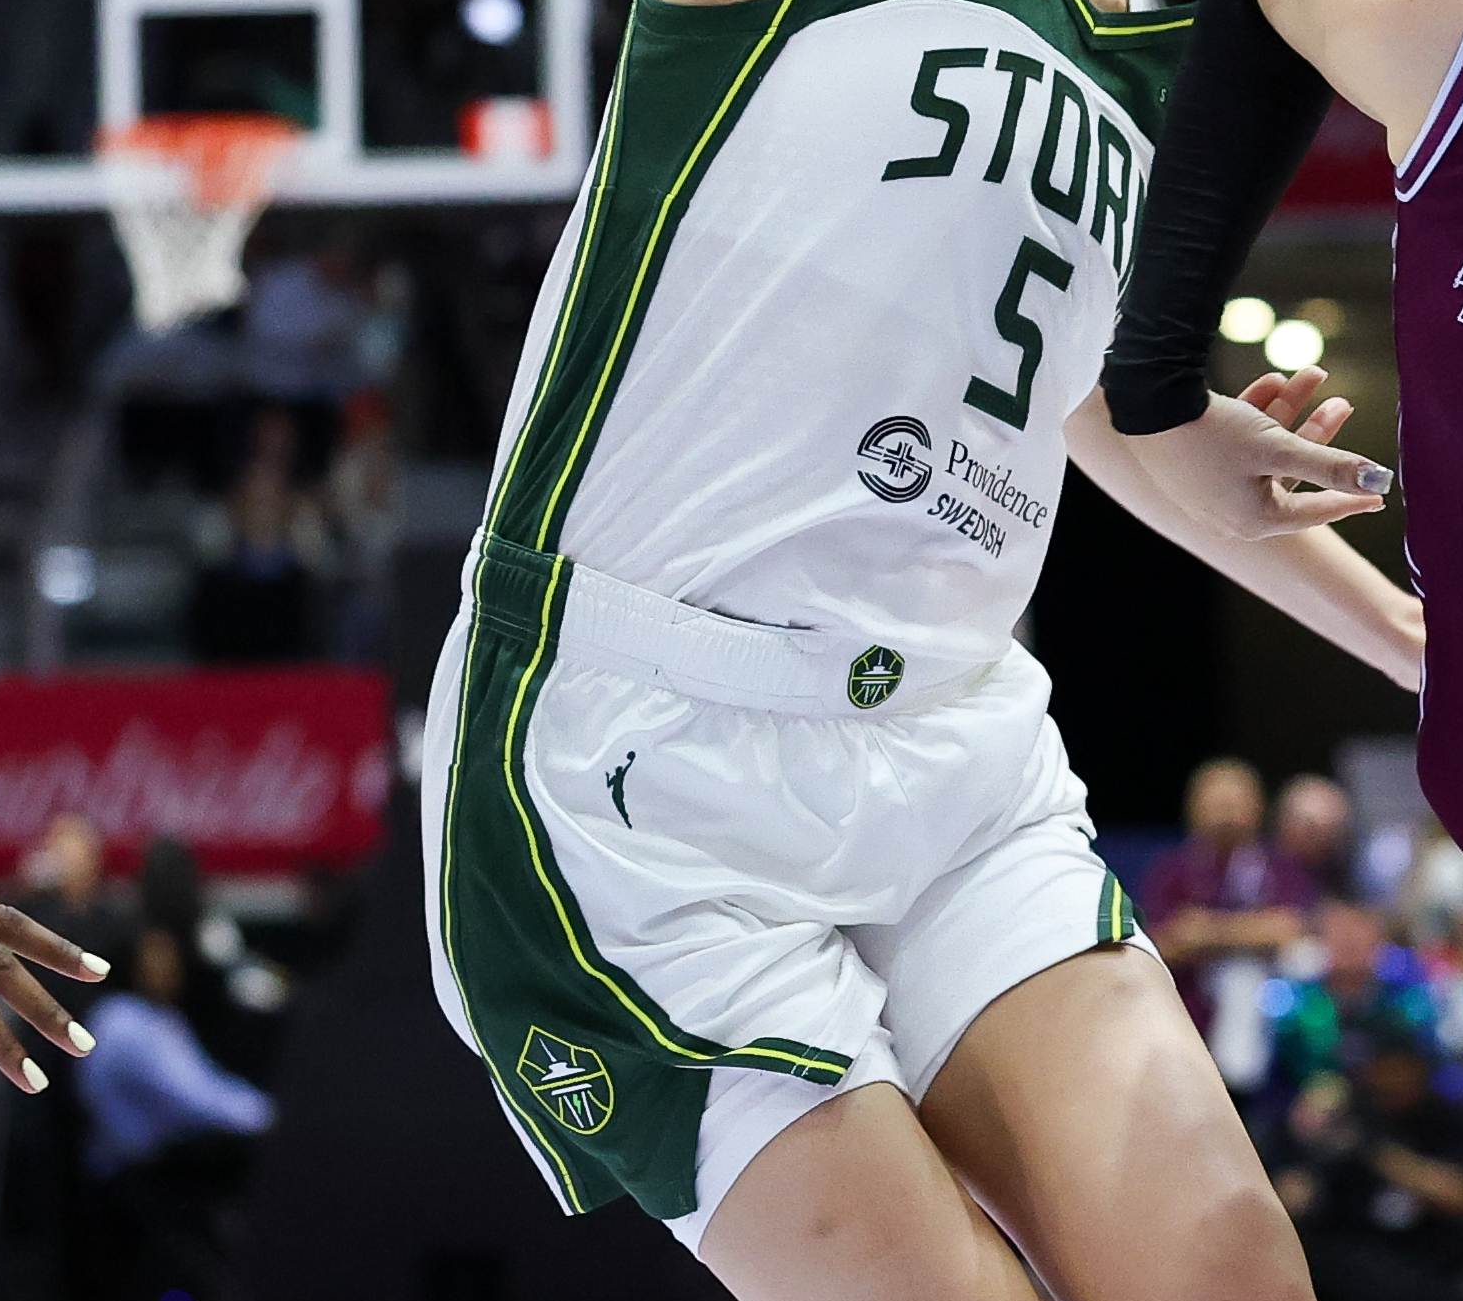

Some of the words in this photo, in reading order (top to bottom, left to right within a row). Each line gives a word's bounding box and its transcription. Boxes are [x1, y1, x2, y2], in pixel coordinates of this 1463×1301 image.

[881, 47, 1148, 299] STOR
[962, 235, 1075, 432] 5
[926, 493, 1007, 559] SWEDISH
[944, 439, 1048, 529] Providence
